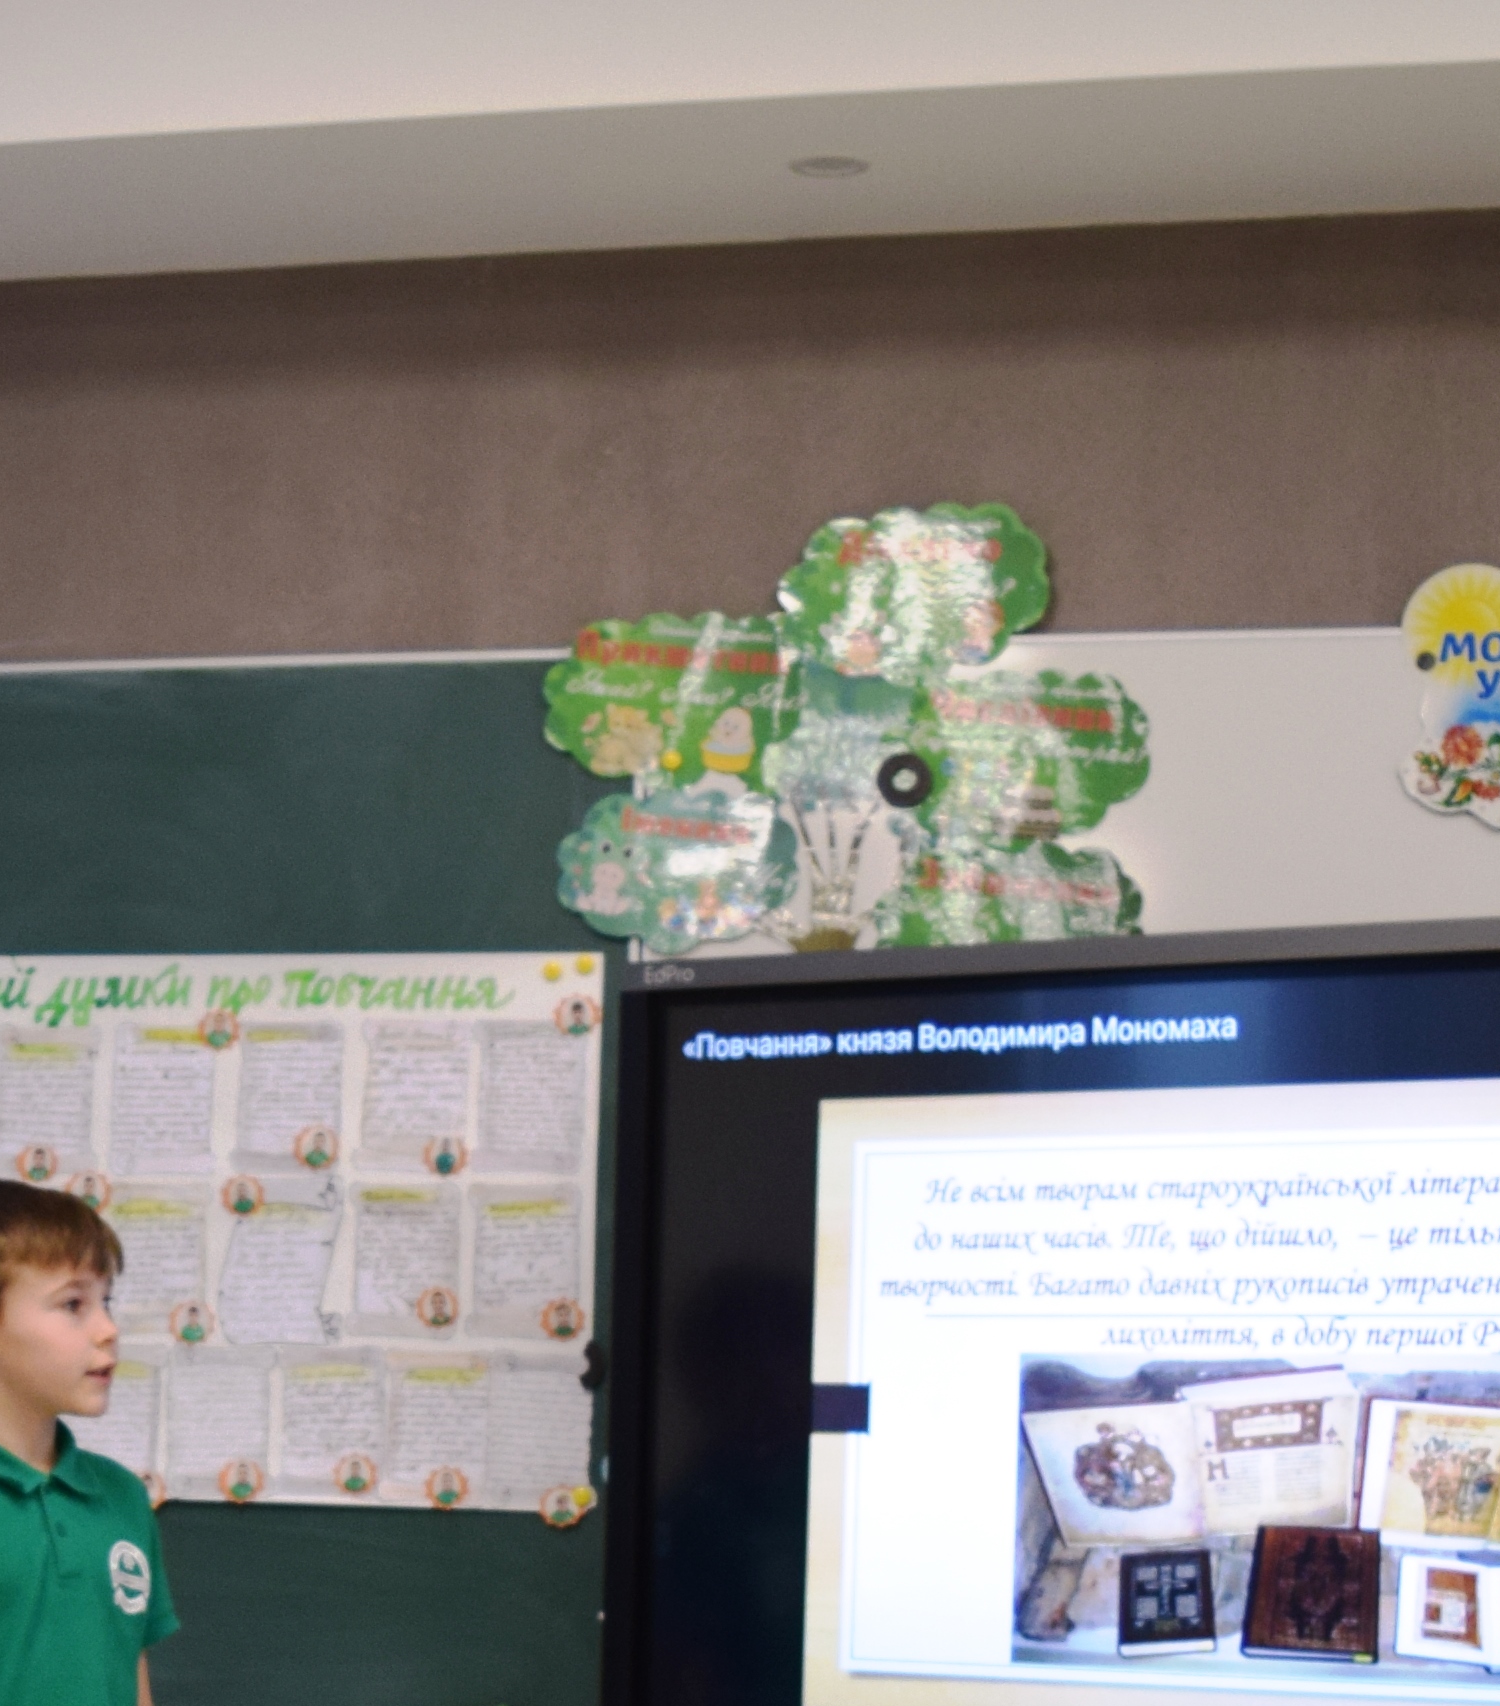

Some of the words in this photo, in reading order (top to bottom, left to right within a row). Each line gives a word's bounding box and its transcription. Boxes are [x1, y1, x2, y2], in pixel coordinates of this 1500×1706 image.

[682, 1031, 833, 1062] «Повчання»
[837, 1027, 914, 1056] князя
[917, 1020, 1087, 1053] Володимира
[1092, 1014, 1238, 1045] Мономаха
[926, 1177, 963, 1204] Не
[970, 1177, 1026, 1203] всім
[1035, 1181, 1138, 1209] творам
[1146, 1170, 1392, 1208] староукраїнської
[912, 1223, 942, 1252] до
[951, 1230, 1037, 1254] наших
[1122, 1223, 1177, 1252] Те,
[1189, 1228, 1226, 1253] що
[1235, 1217, 1339, 1252] дійшло,
[1389, 1223, 1420, 1251] це
[879, 1272, 1019, 1305] творчості.
[1028, 1271, 1131, 1298] Багато
[1138, 1271, 1228, 1299] давніх
[1232, 1267, 1369, 1303] рукописів
[1101, 1319, 1260, 1351] лихоліття,
[1271, 1329, 1286, 1347] в
[1294, 1314, 1357, 1353] добу
[1365, 1320, 1466, 1351] першої
